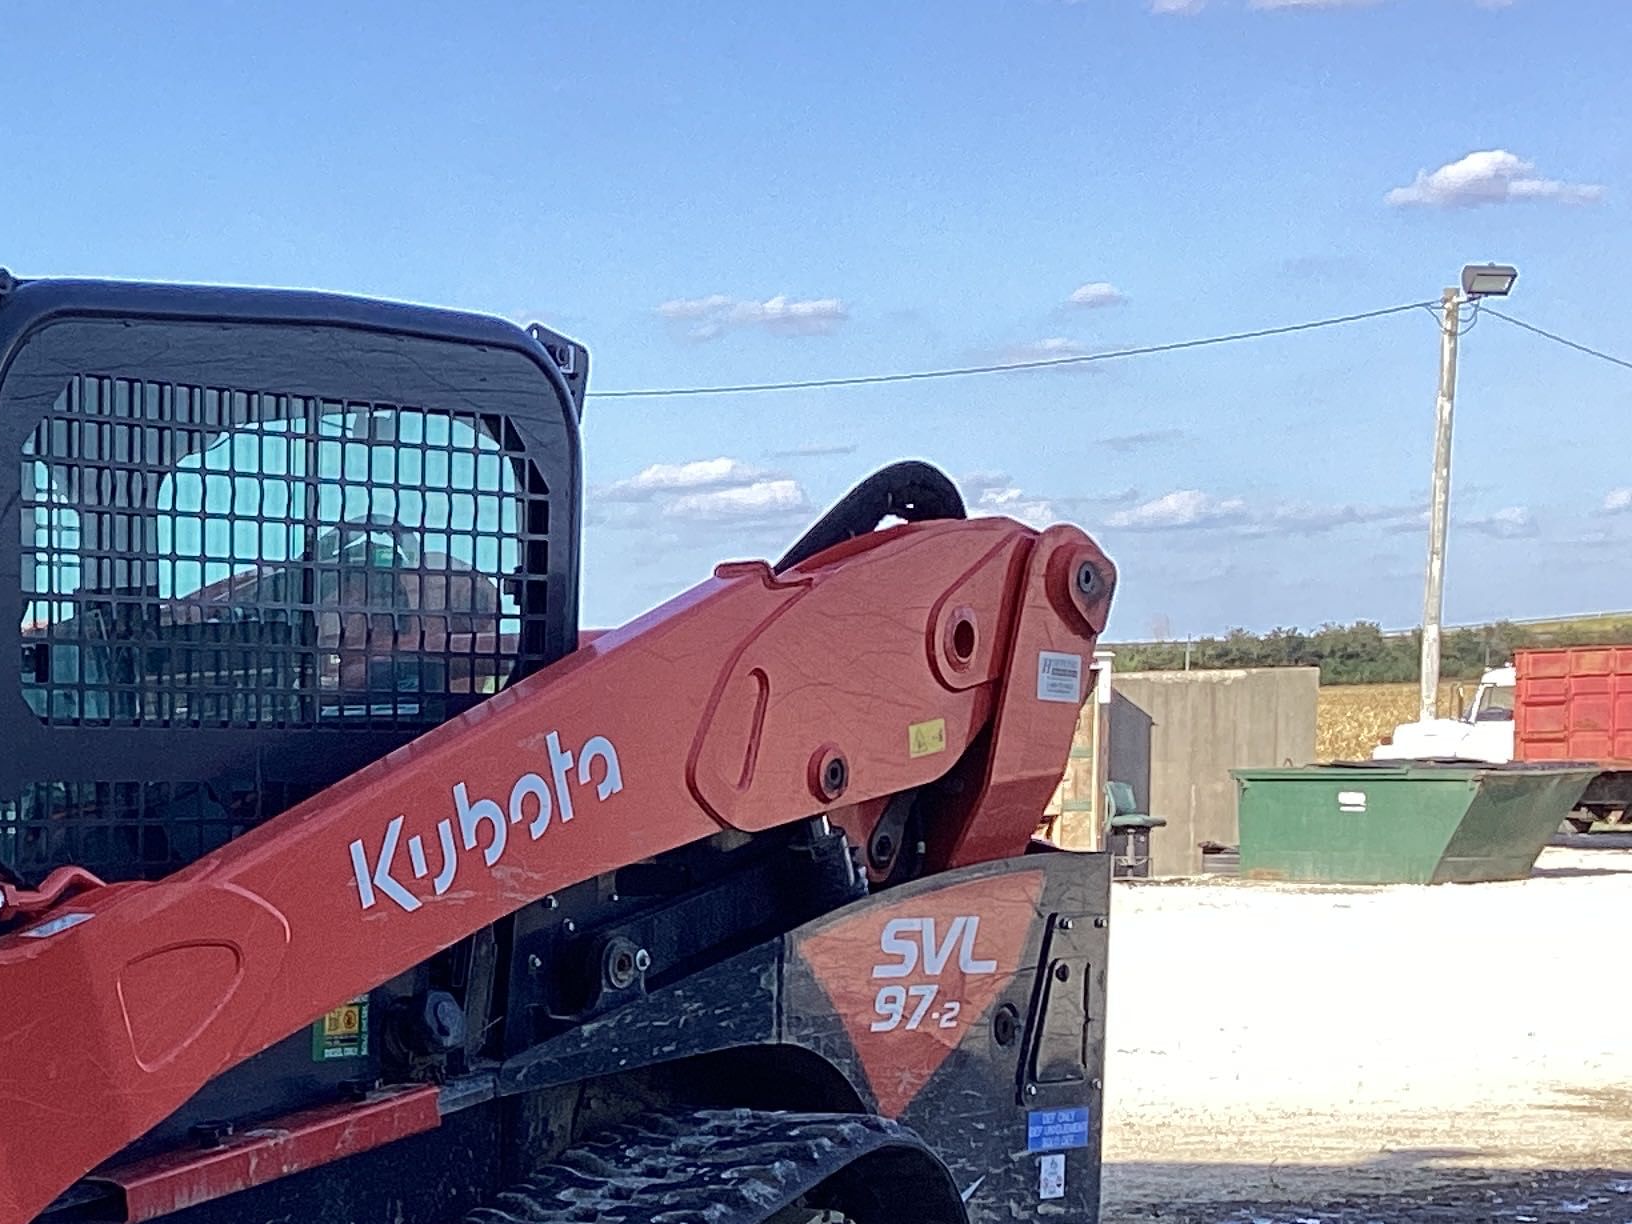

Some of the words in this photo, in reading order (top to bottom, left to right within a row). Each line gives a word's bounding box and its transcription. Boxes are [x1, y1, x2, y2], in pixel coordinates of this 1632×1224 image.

[349, 730, 624, 912] Kubota
[872, 915, 998, 978] SVL
[870, 984, 961, 1033] 97-2
